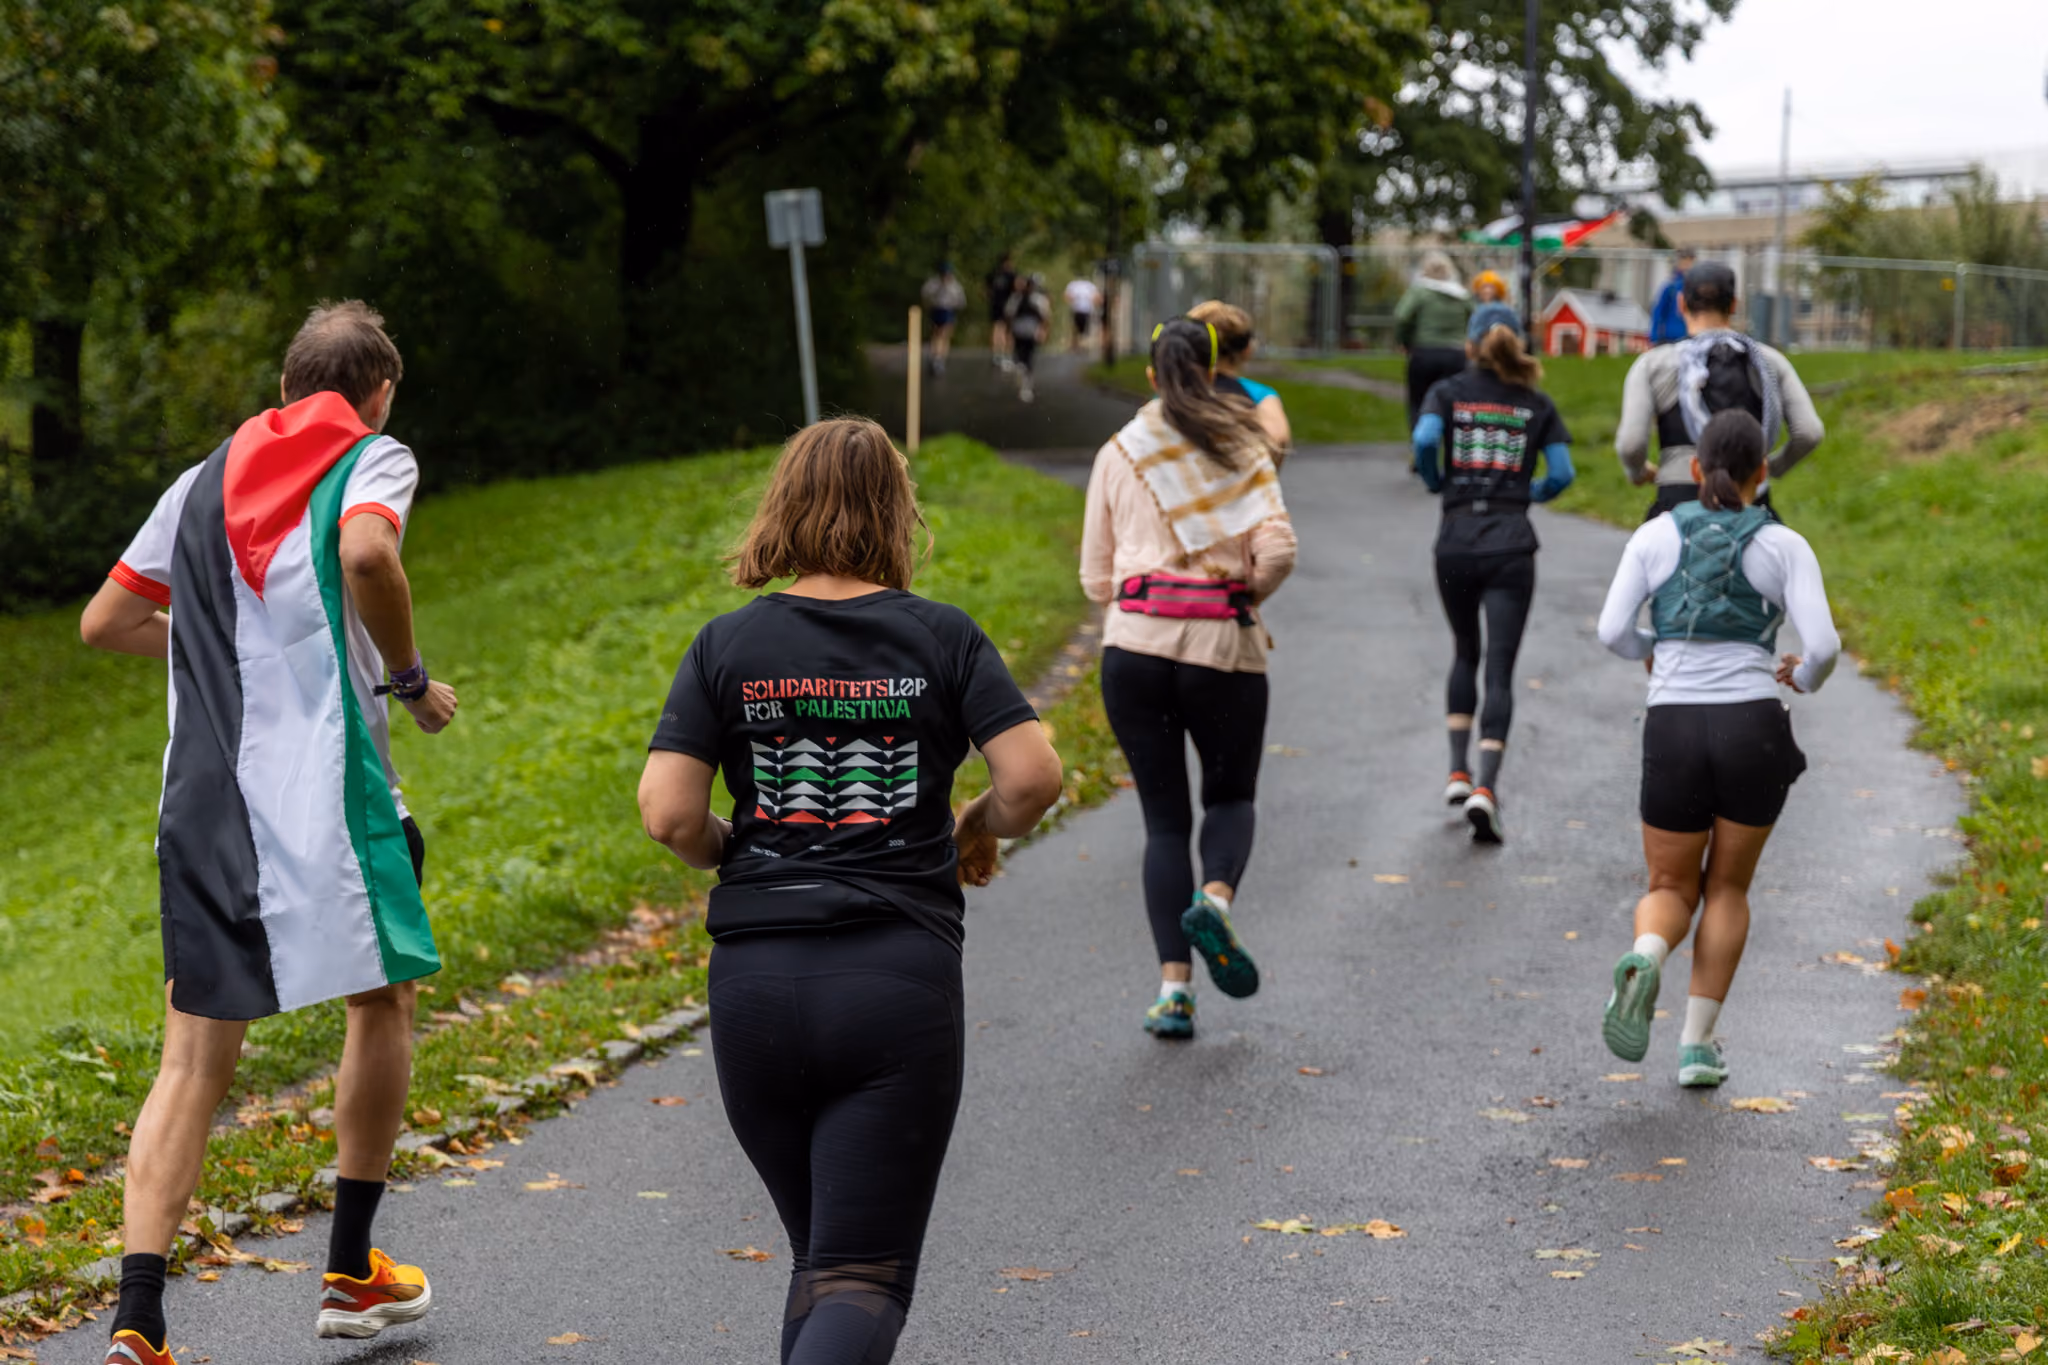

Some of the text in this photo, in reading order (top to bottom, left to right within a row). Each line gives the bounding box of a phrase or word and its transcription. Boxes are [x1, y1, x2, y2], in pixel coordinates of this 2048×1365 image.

[742, 678, 928, 701] SOLIDARITETSLØP
[743, 699, 911, 722] FOR PALESTINA
